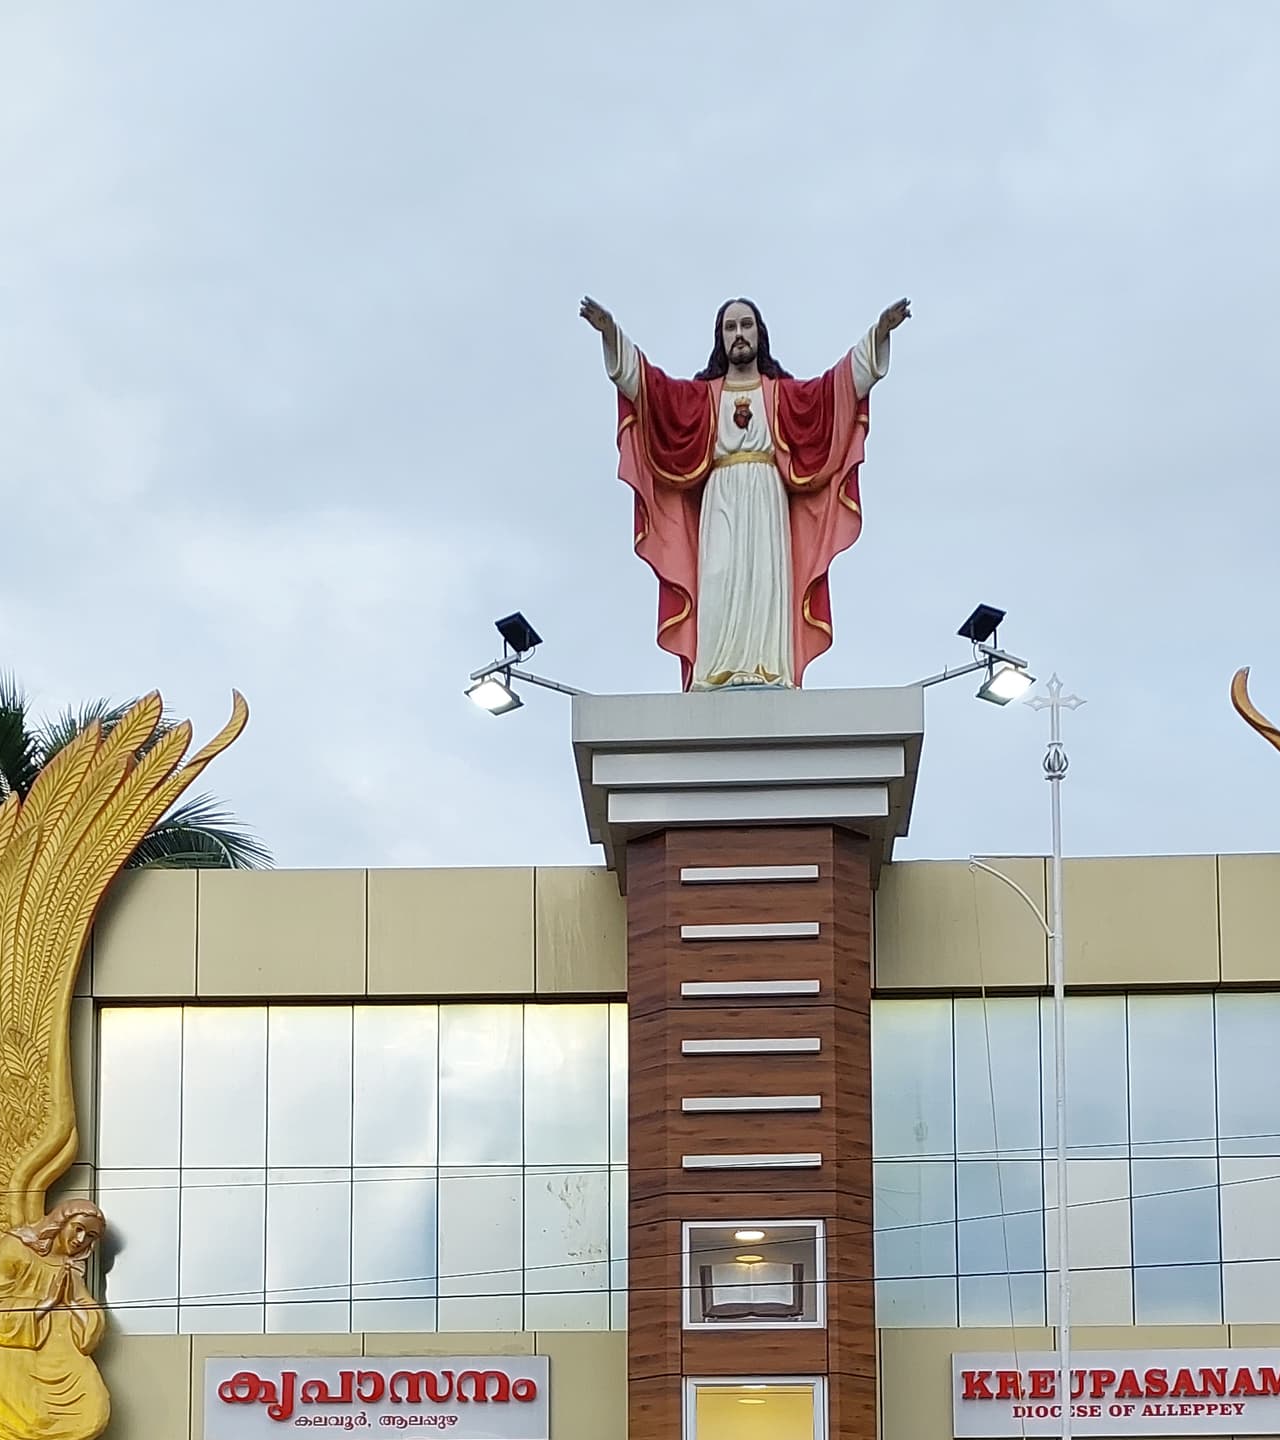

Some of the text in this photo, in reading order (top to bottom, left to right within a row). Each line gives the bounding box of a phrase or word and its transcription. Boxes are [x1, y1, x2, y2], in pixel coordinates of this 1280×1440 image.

[218, 1370, 538, 1421] കൃപാസനം
[1109, 1404, 1136, 1417] OF
[1141, 1402, 1246, 1417] ALLEPPEY
